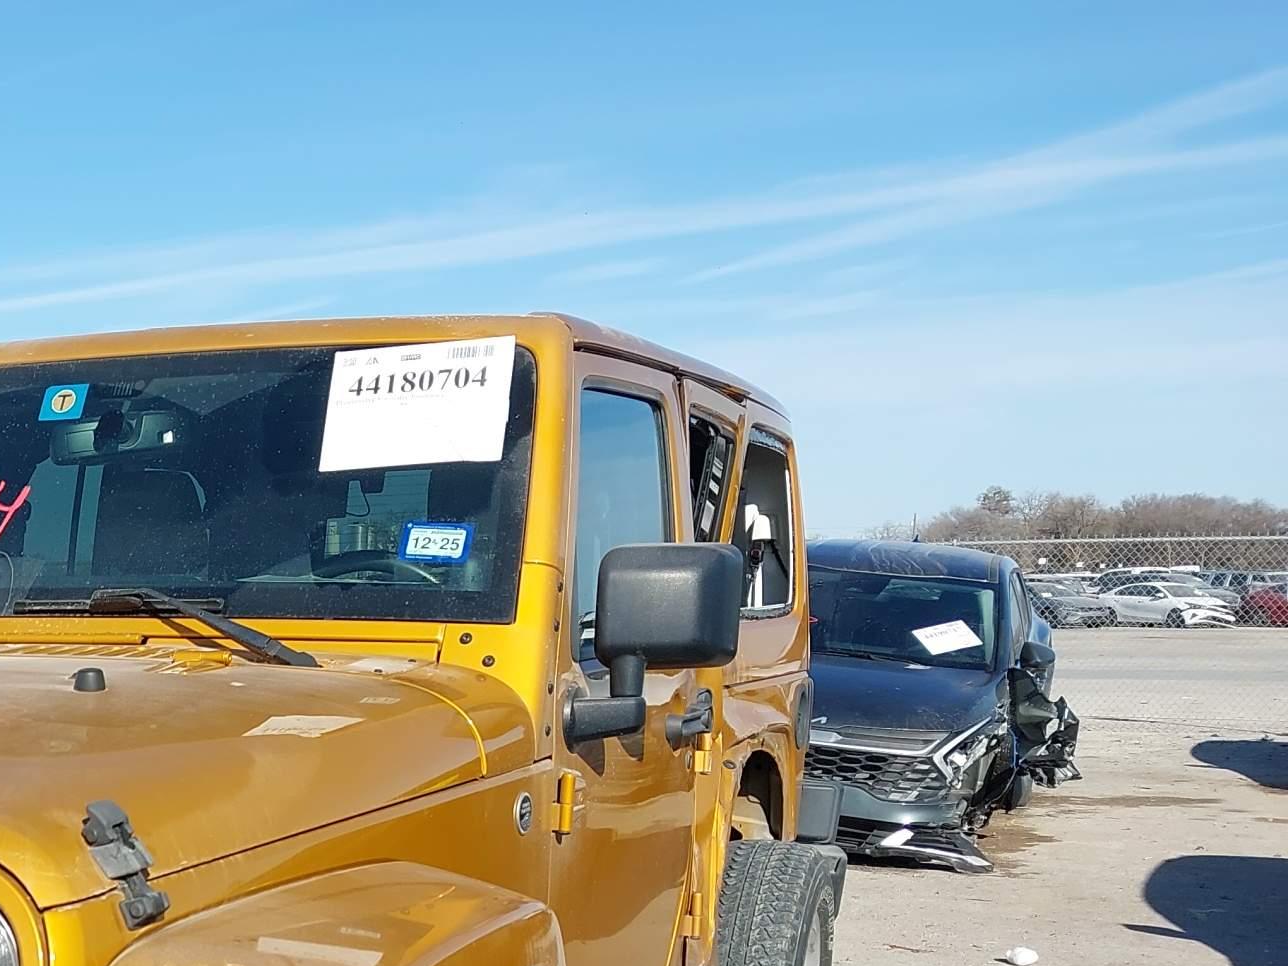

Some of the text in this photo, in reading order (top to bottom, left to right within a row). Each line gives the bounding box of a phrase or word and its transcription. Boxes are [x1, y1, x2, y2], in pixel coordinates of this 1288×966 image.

[348, 366, 488, 396] 44180704
[57, 393, 73, 411] T
[413, 536, 461, 551] 12 25
